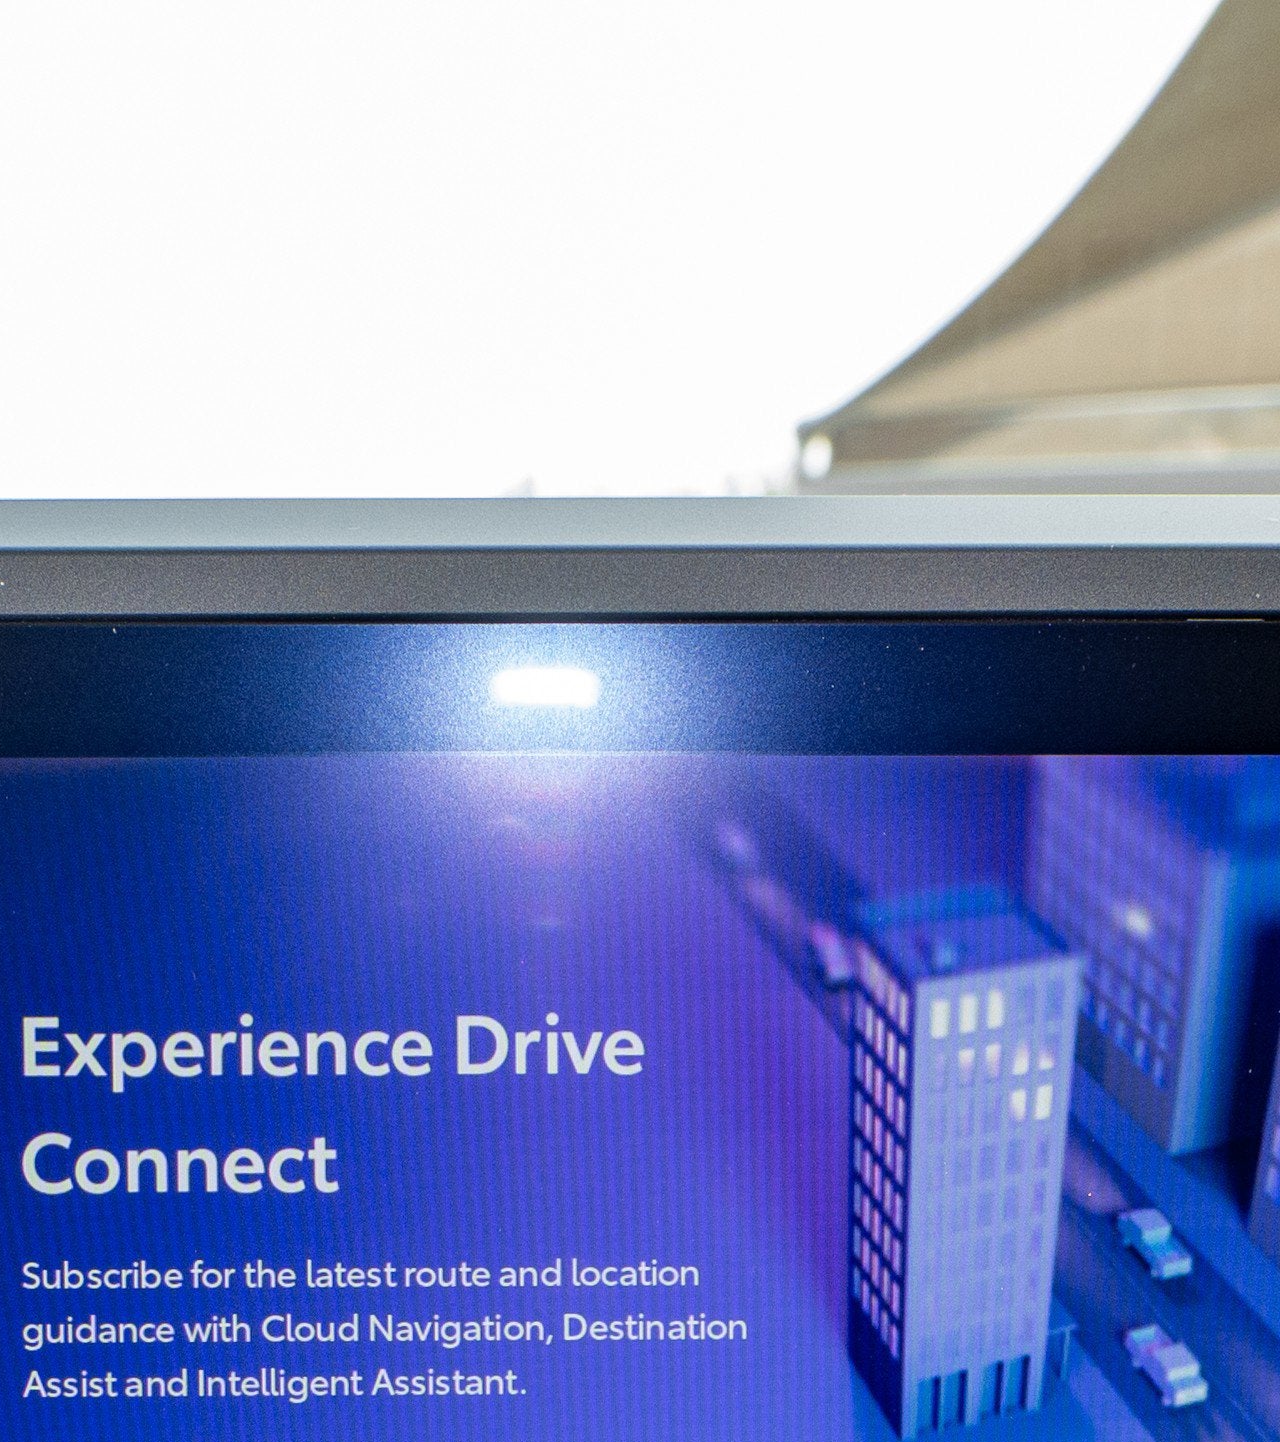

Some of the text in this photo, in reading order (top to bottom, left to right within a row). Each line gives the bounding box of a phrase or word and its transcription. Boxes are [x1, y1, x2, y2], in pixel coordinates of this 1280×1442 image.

[20, 1011, 646, 1094] Experience Drive
[20, 1132, 341, 1196] Connect
[21, 1257, 701, 1292] Subscribe for the latest route and location
[21, 1312, 748, 1350] guidance with Cloud Navigation, Destination
[22, 1366, 528, 1404] Assist and Intelligent Assistant.
